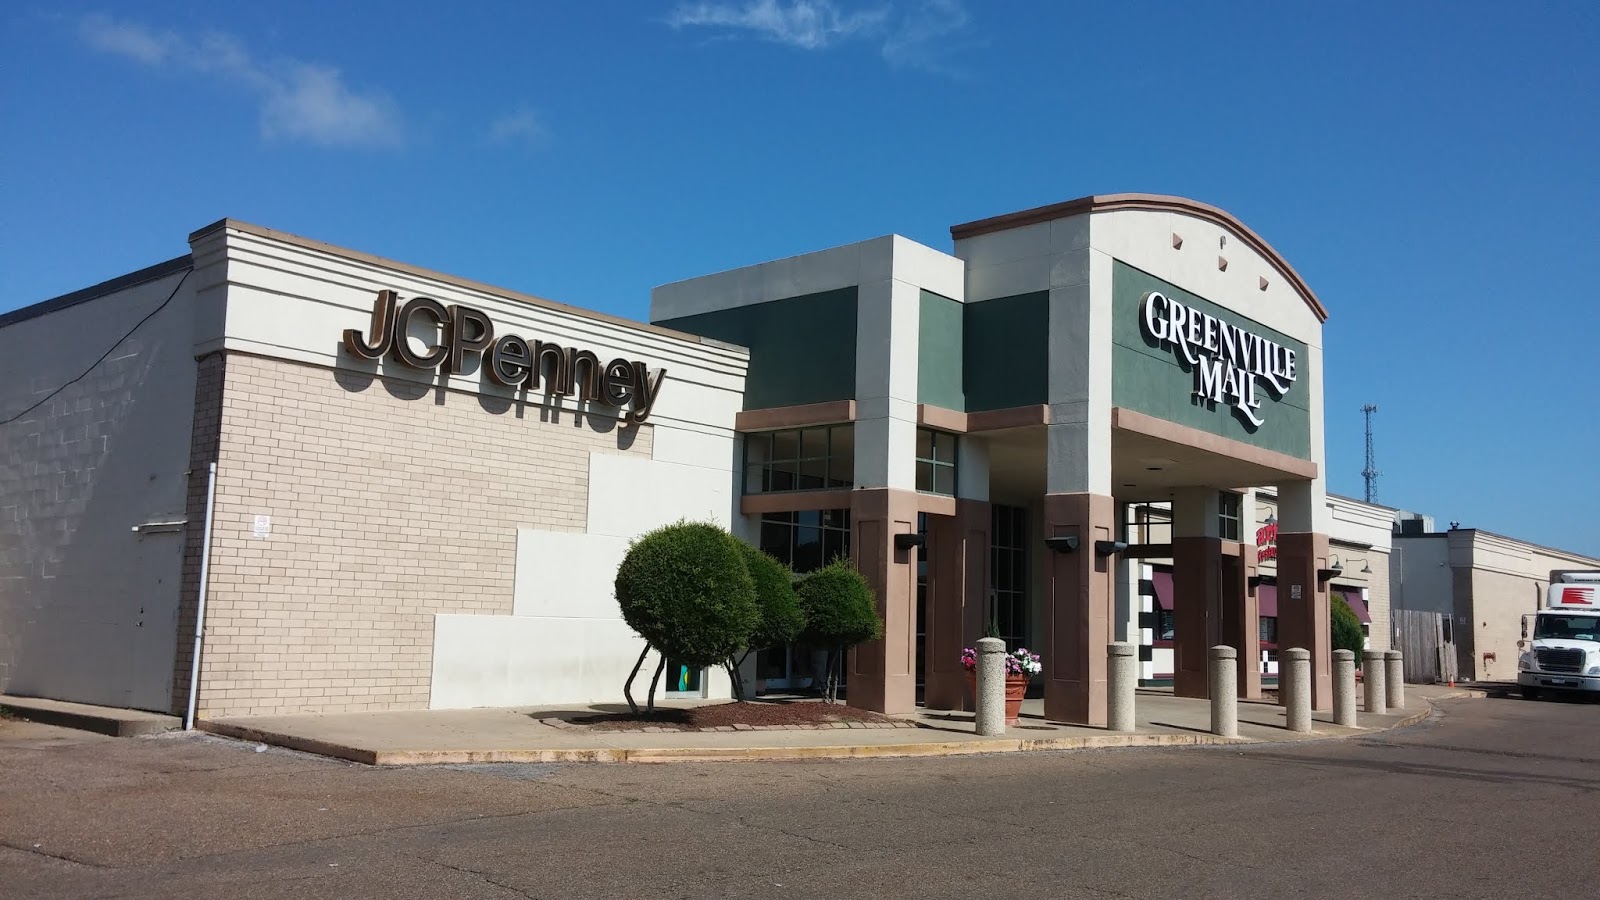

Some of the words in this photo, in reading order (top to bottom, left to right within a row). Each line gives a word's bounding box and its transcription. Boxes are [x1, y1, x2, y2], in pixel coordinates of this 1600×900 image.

[343, 290, 666, 424] JCPenney
[1143, 291, 1297, 395] GREENVILLE
[1196, 354, 1265, 427] MALL
